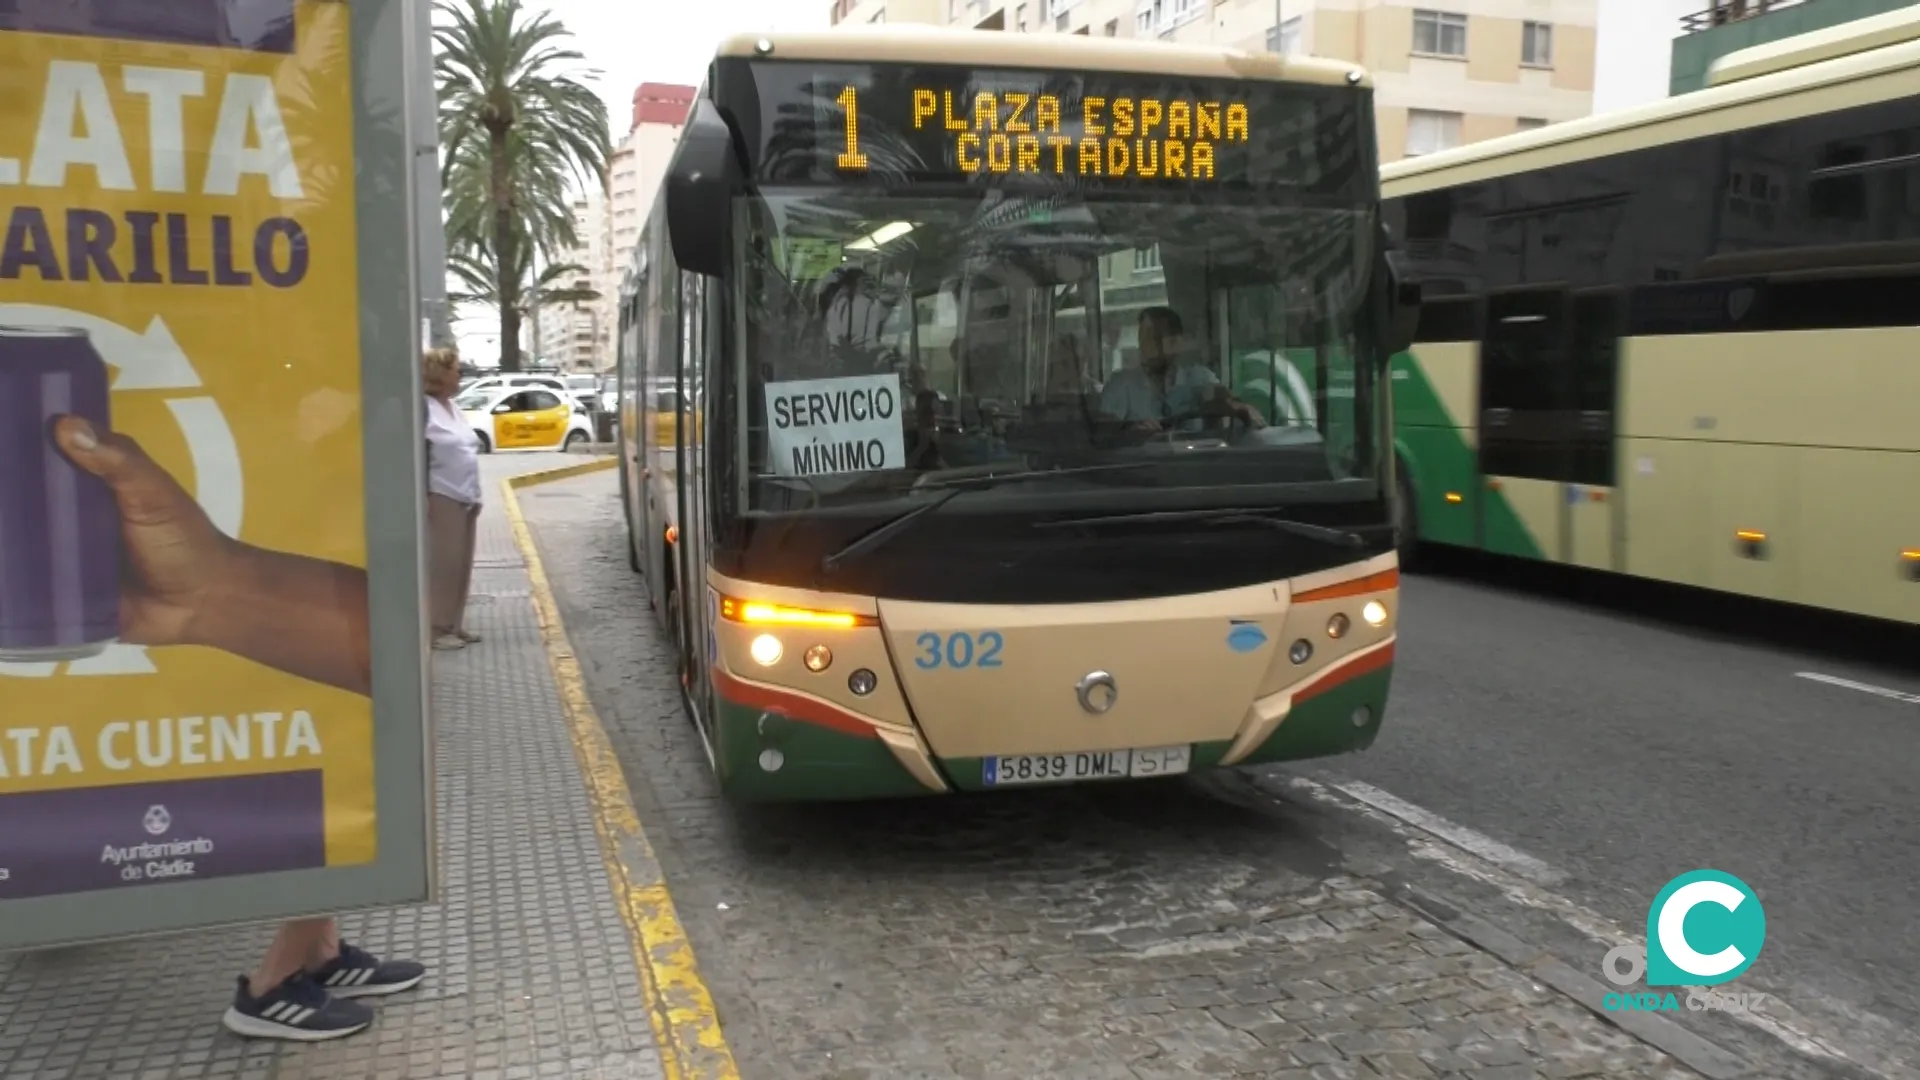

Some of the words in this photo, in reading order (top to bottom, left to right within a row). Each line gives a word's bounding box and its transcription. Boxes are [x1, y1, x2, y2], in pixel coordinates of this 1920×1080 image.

[836, 85, 868, 170] 1
[913, 88, 1061, 134] PLAZA
[1083, 97, 1249, 142] ESPAÑA
[956, 132, 1215, 179] CORTADURA
[773, 387, 894, 429] SERVICIO
[792, 436, 886, 476] MÍNIMO
[914, 630, 1005, 670] 302
[97, 709, 322, 770] CUENTA
[1000, 755, 1069, 780] 5839
[1075, 750, 1122, 777] DML
[101, 836, 214, 866] Ayuntamiento
[121, 863, 143, 881] de
[145, 859, 197, 878] Cádiz
